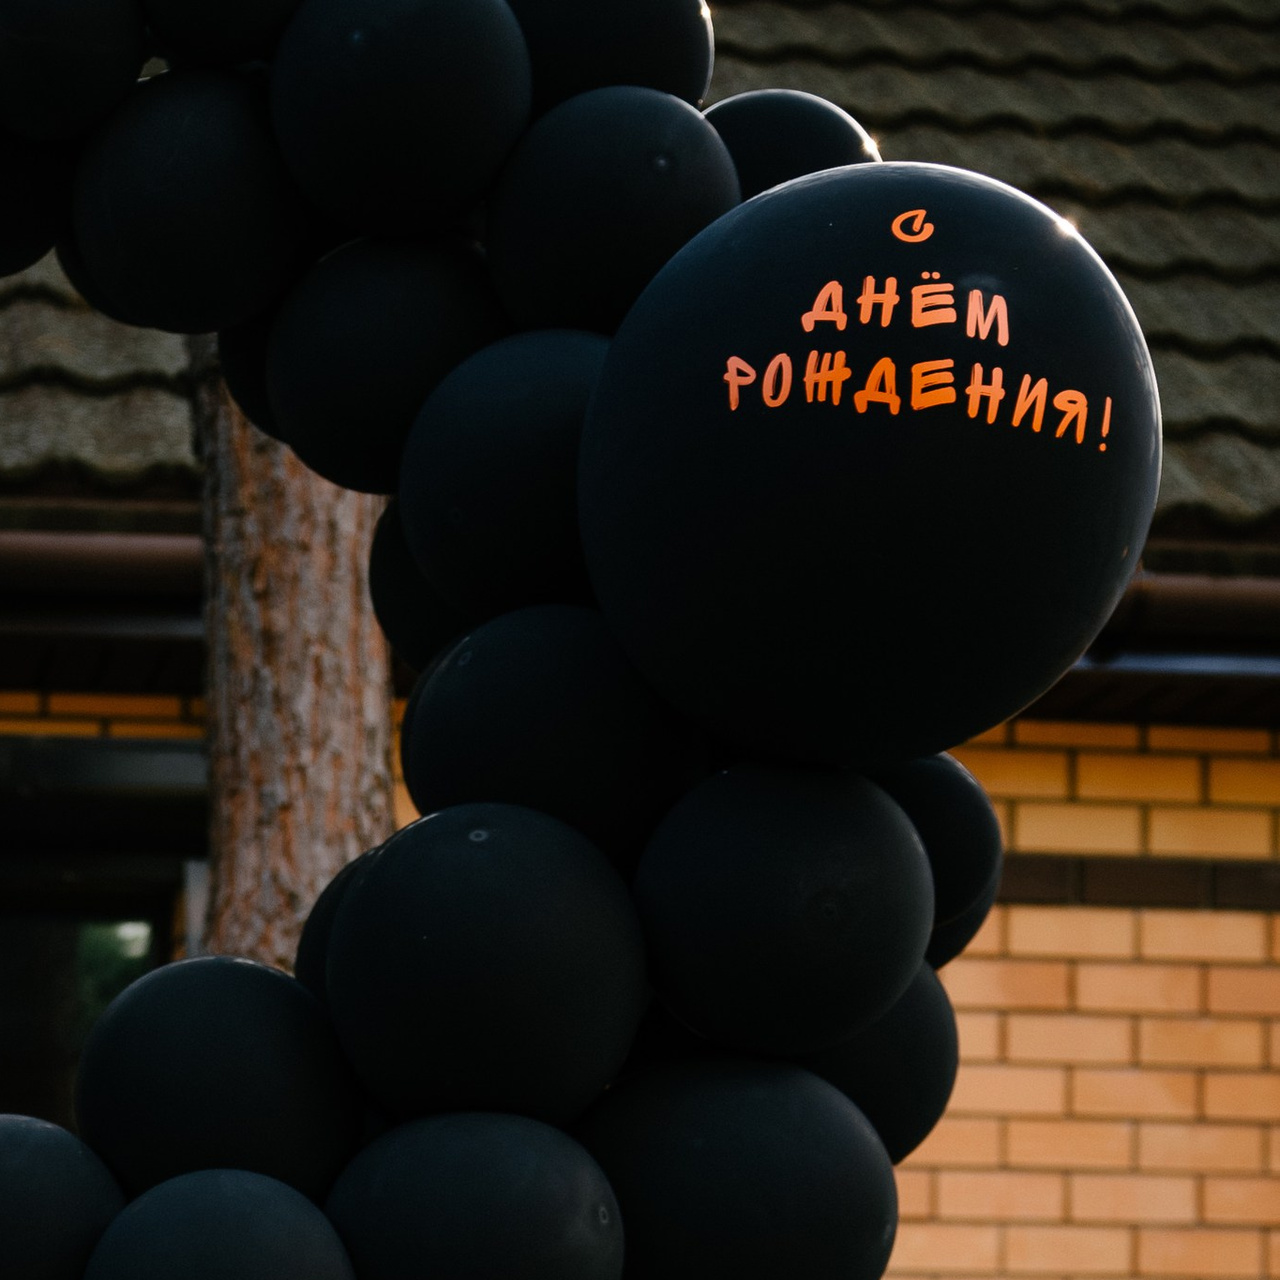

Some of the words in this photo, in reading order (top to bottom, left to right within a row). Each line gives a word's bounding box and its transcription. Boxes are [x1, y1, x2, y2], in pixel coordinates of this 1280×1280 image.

[891, 209, 935, 243] С
[800, 271, 1010, 347] ДНЁМ
[723, 349, 1113, 452] РОЖДЕНИЯ!
